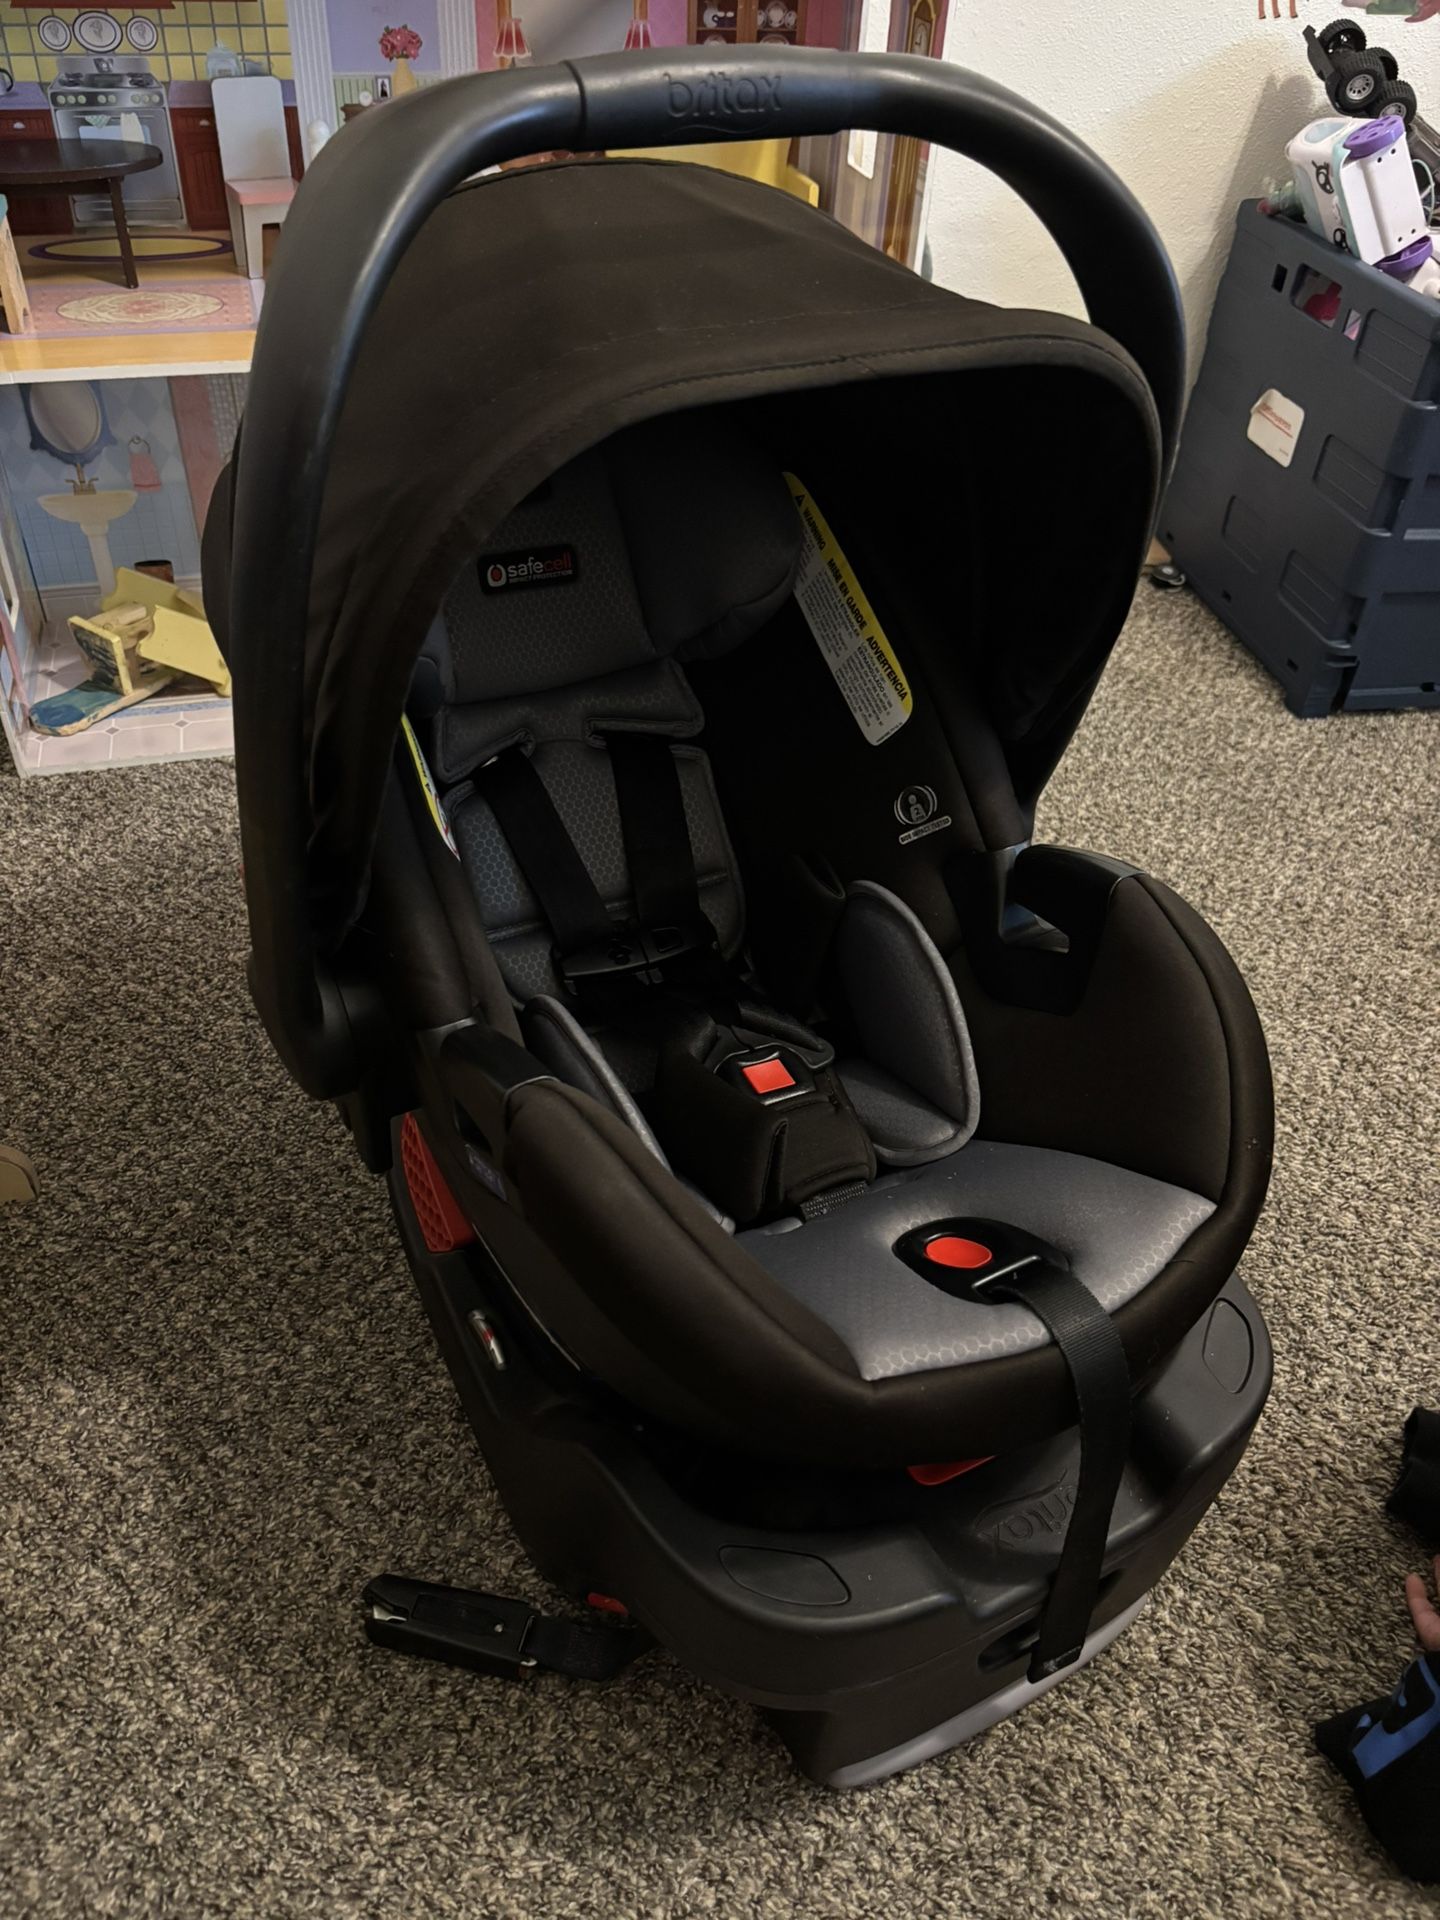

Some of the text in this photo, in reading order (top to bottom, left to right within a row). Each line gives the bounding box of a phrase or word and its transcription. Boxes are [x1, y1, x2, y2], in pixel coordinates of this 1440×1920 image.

[662, 71, 782, 118] britax
[802, 506, 827, 551] WARNING
[507, 552, 572, 578] safecell
[839, 581, 850, 598] EN
[846, 596, 867, 631] GARDE
[866, 635, 909, 701] ADVERTENCIA
